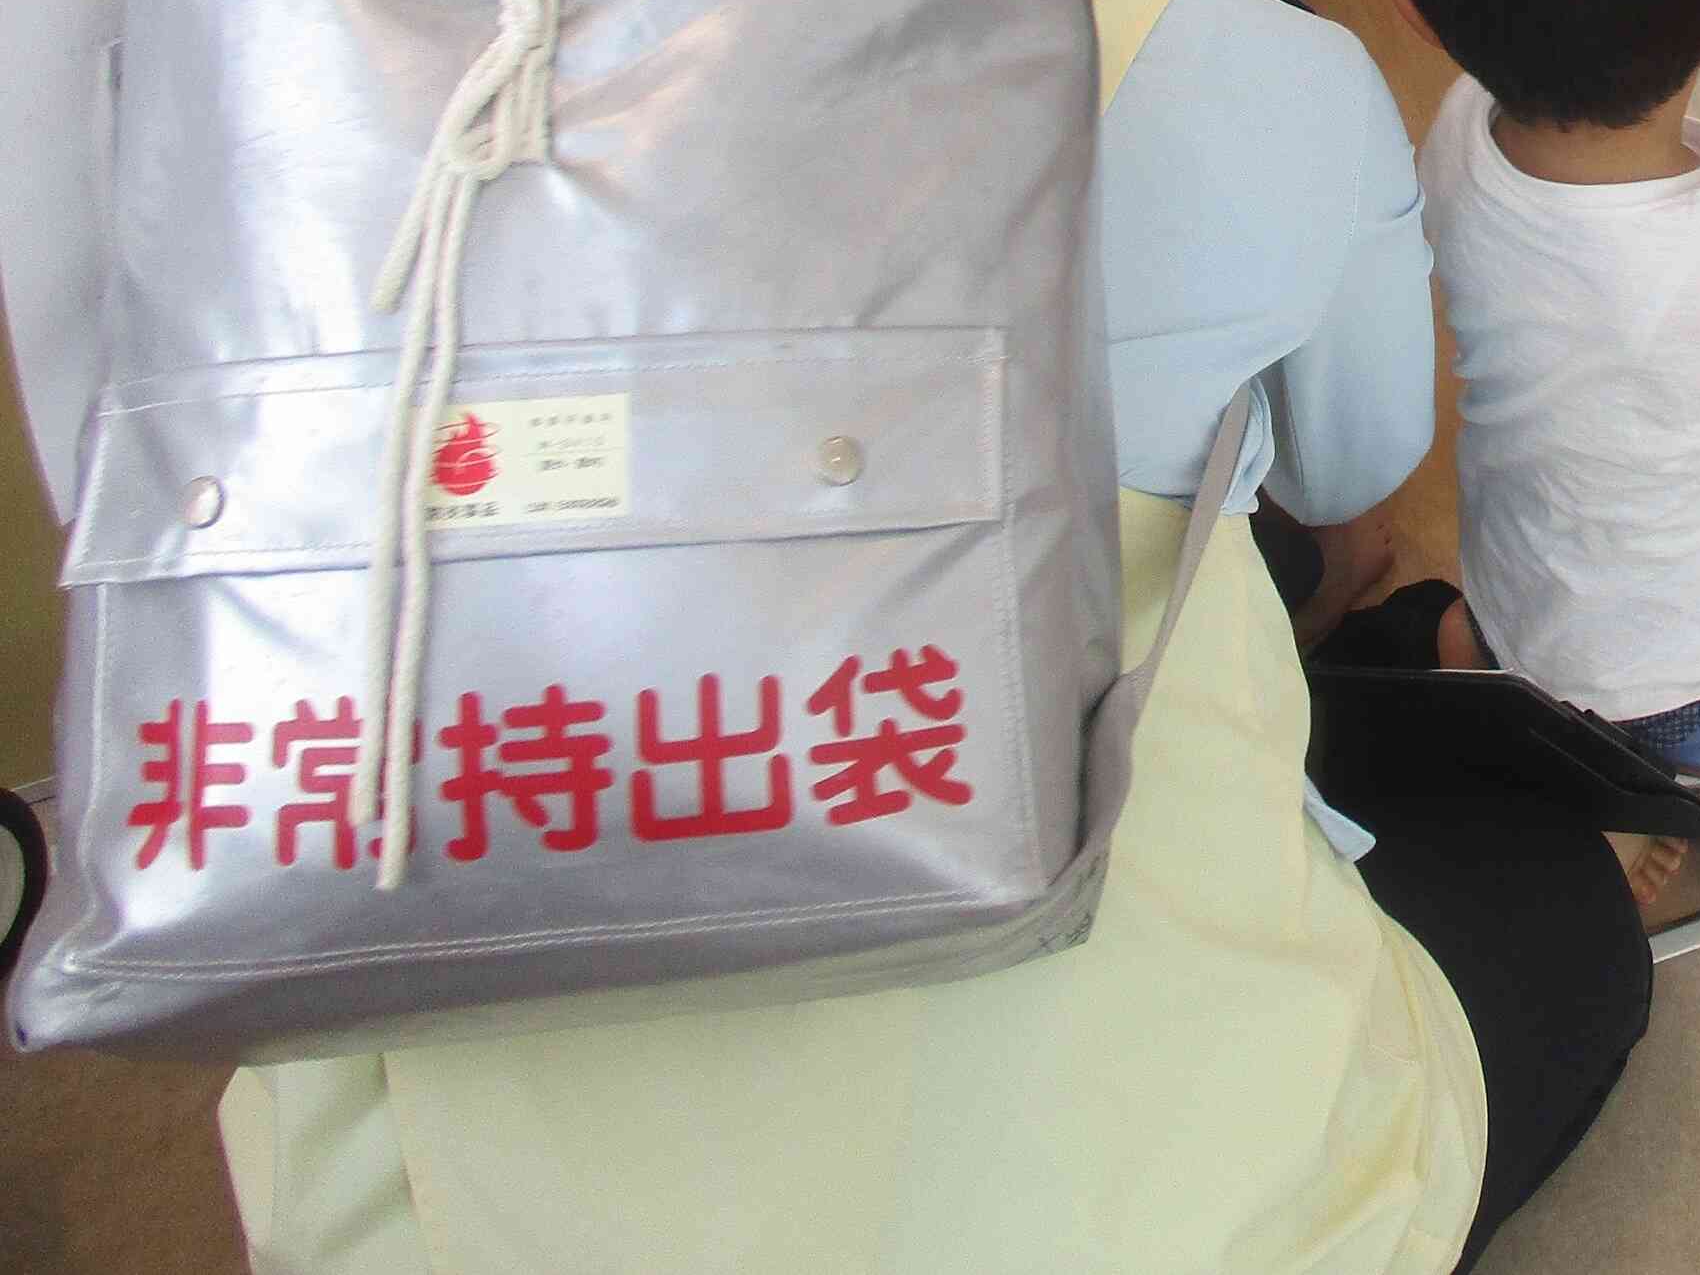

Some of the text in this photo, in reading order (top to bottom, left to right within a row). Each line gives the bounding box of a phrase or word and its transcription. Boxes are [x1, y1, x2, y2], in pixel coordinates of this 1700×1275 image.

[126, 643, 974, 871] 非常持出袋
